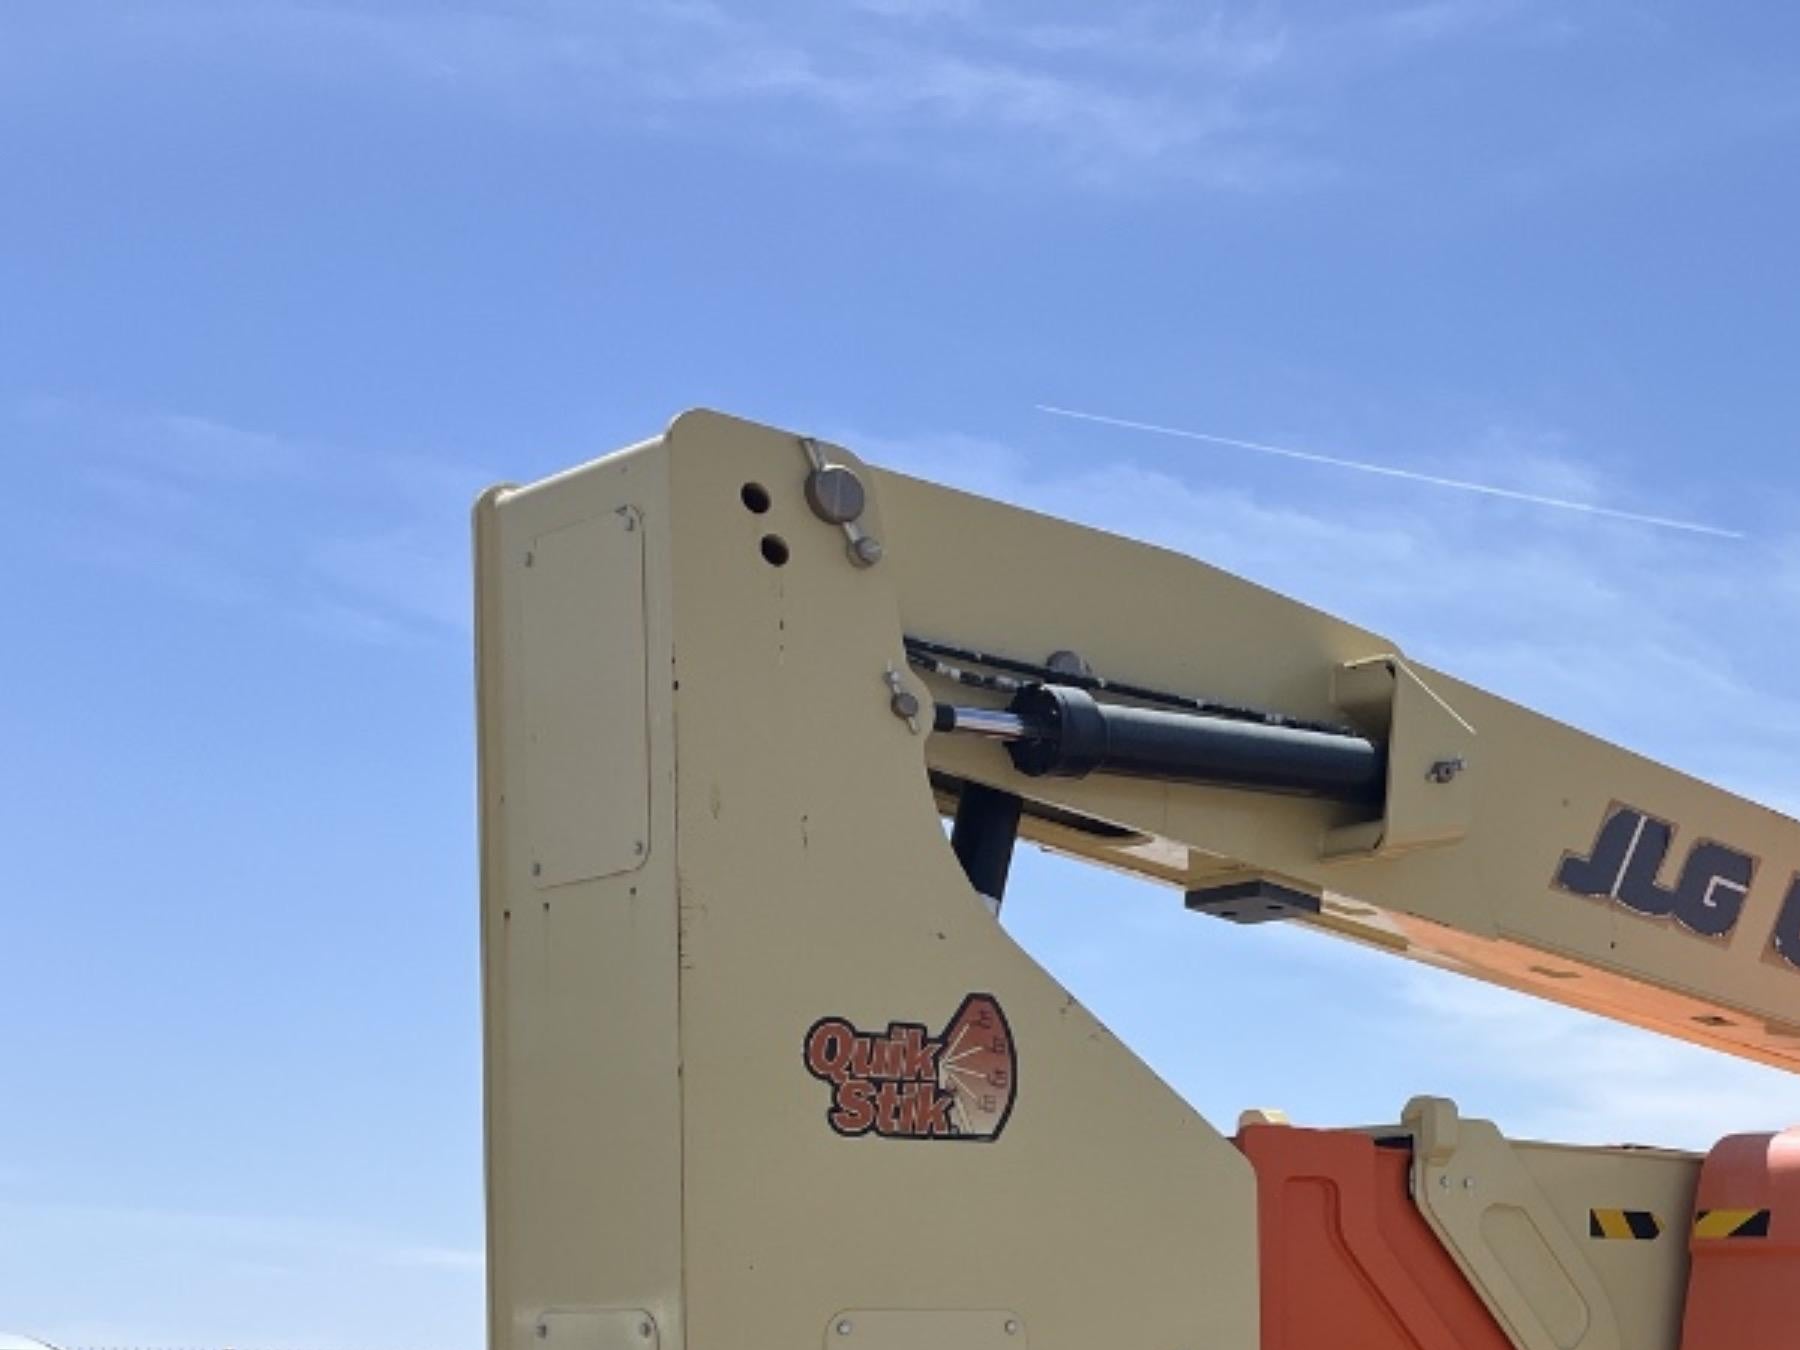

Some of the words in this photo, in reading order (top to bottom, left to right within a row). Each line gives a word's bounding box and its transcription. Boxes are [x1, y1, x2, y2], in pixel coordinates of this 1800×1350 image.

[1554, 804, 1758, 942] JLG
[807, 1021, 943, 1083] Quik
[832, 1079, 953, 1134] Stik
